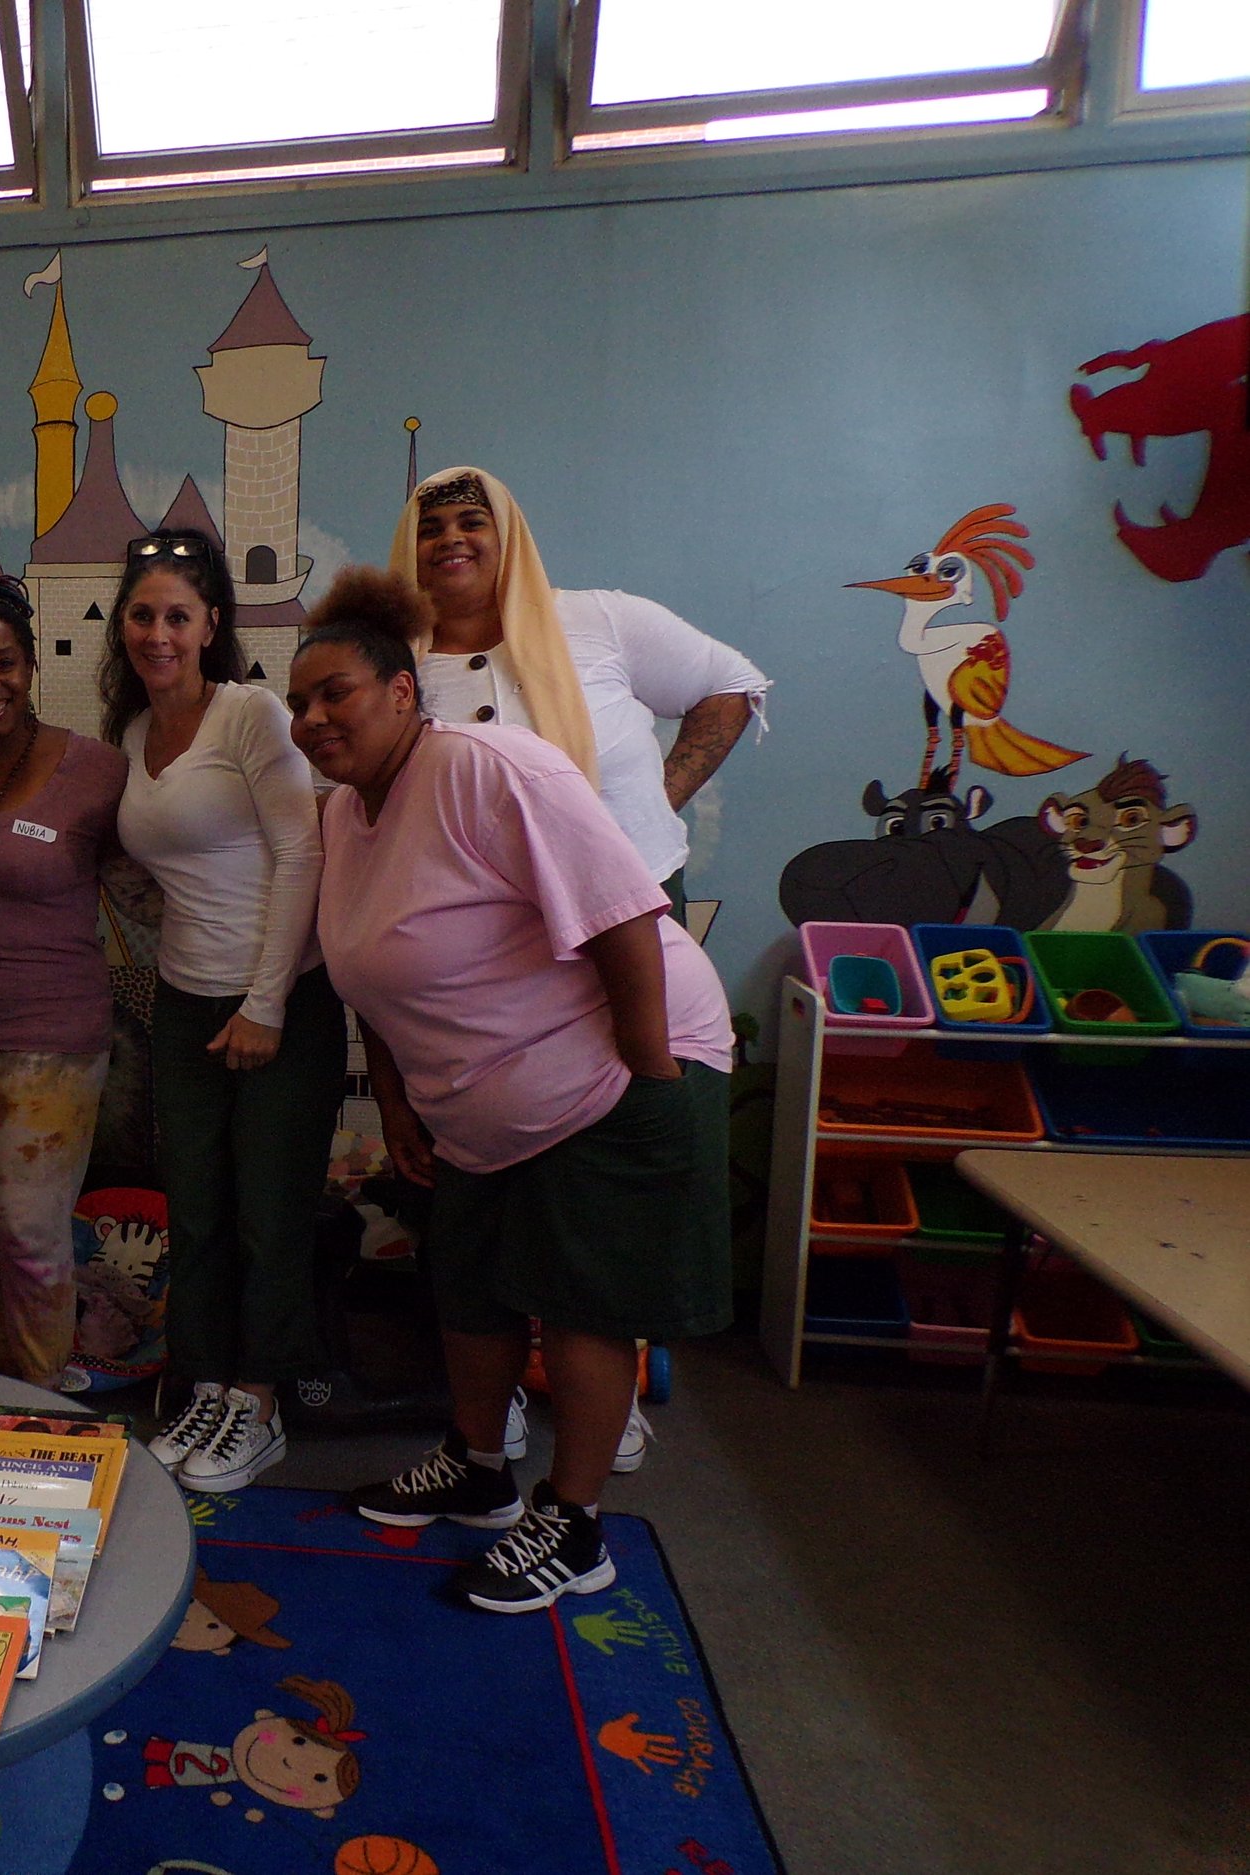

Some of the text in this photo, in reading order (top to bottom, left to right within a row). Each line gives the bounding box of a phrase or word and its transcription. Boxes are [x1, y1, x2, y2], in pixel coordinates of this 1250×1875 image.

[16, 822, 47, 839] NUBIA
[30, 1449, 56, 1462] THE
[58, 1452, 105, 1464] BEAST
[46, 1464, 80, 1473] AND
[33, 1516, 71, 1530] Nest
